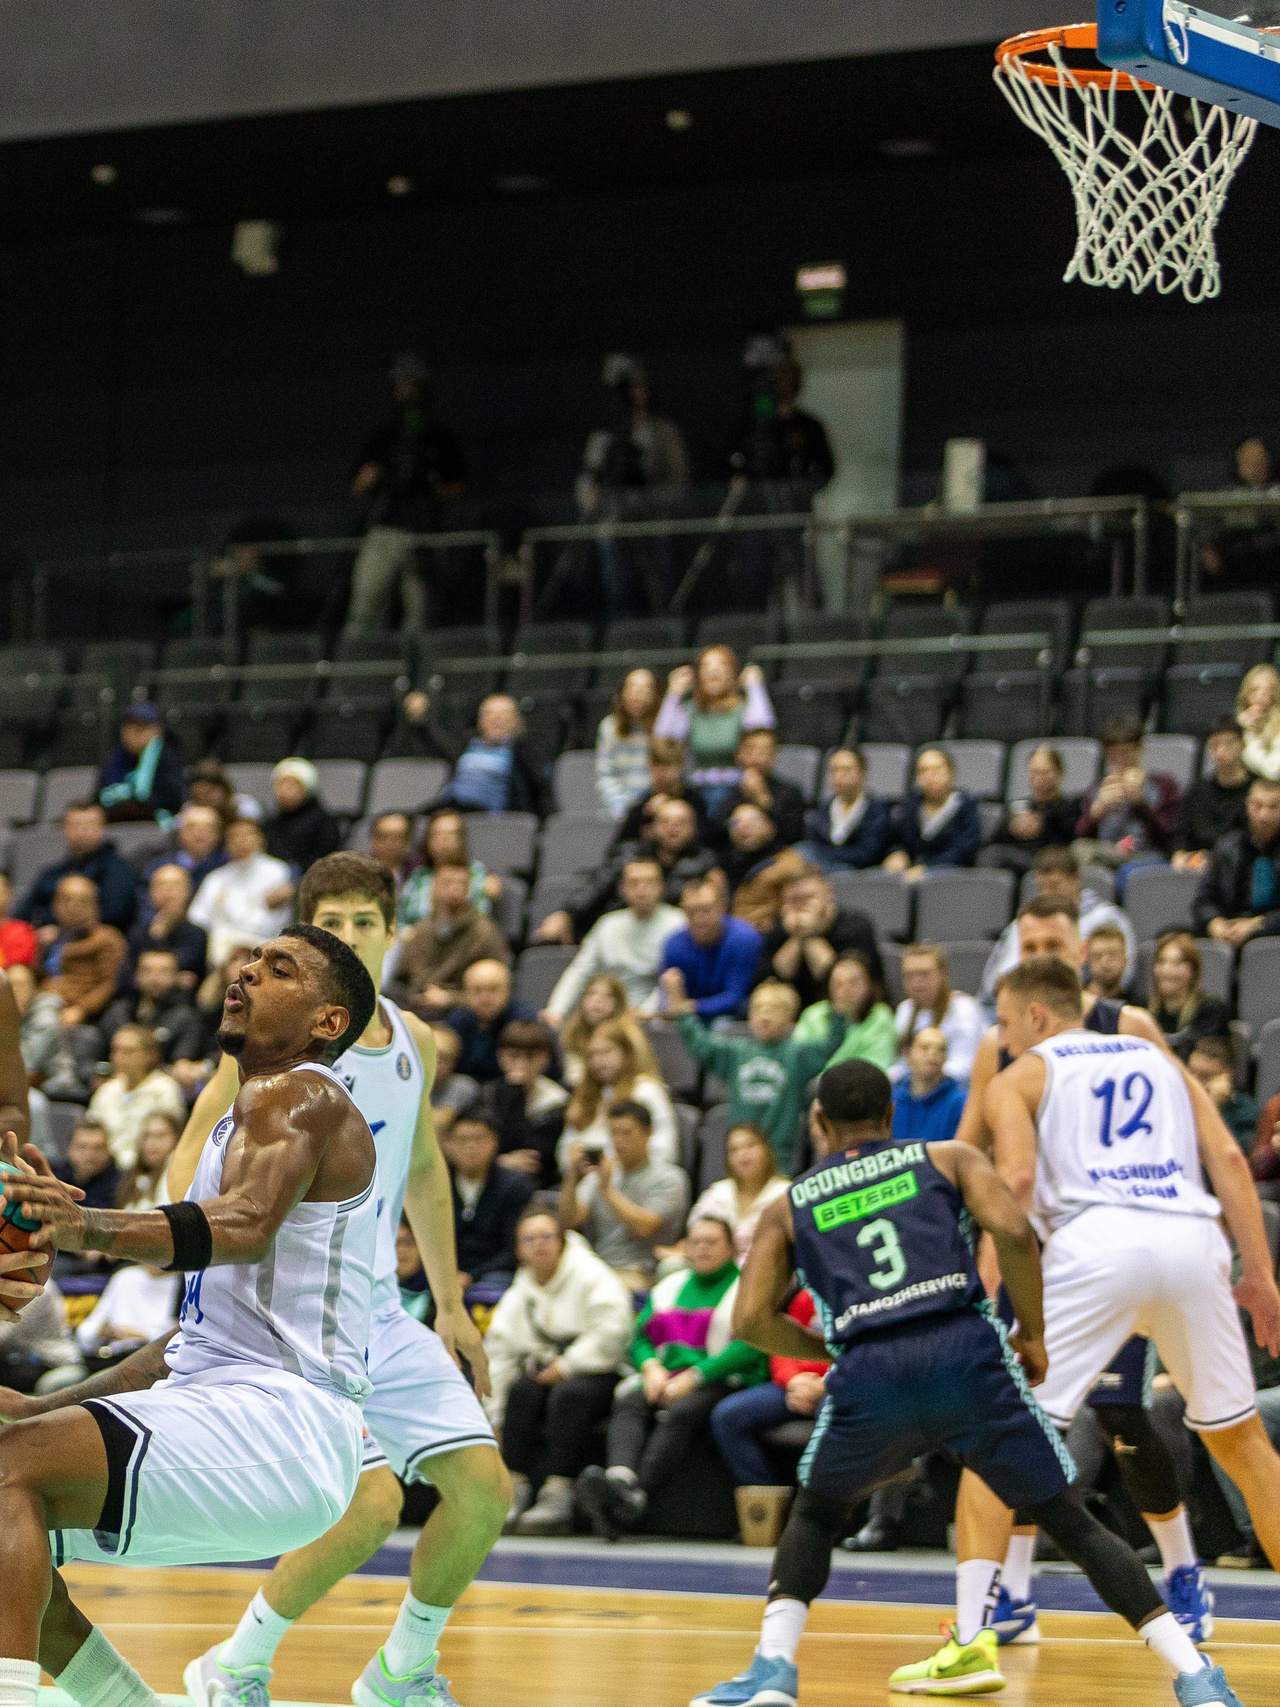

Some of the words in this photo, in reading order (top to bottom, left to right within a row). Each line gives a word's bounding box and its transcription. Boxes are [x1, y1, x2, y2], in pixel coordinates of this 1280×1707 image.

[1091, 1071, 1153, 1147] 12
[791, 1143, 927, 1208] OGUNGBEMI
[821, 1178, 911, 1223] BETERA
[856, 1217, 908, 1291] 3
